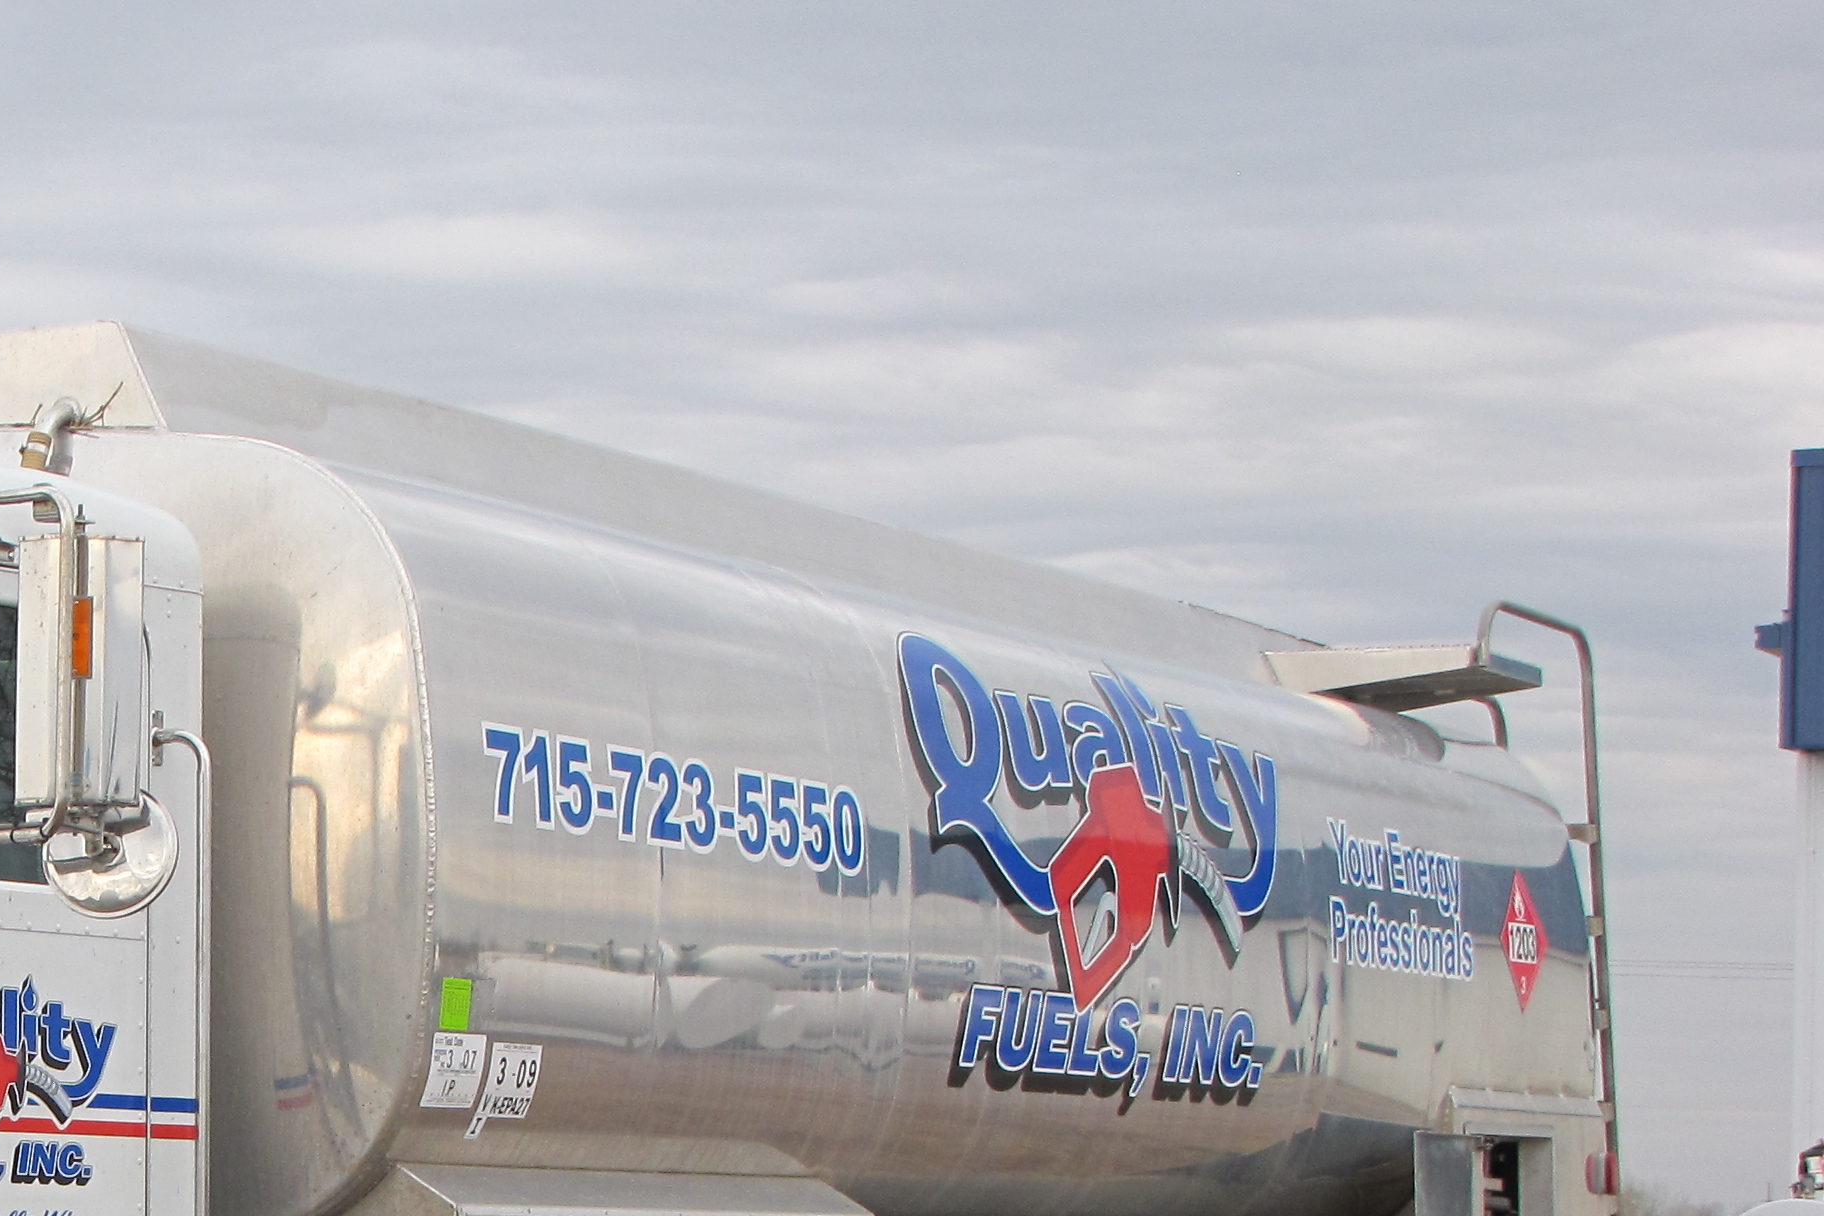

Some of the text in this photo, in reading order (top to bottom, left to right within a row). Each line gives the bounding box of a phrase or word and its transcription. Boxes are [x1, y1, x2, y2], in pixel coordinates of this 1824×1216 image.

[482, 721, 864, 877] 715-723-5550
[898, 631, 1276, 918] Quality
[1327, 817, 1461, 917] Your Energy
[1329, 896, 1474, 982] Professionals
[1509, 925, 1536, 962] 1203
[1519, 976, 1527, 994] 3
[496, 1057, 507, 1085] 3
[956, 984, 1263, 1098] FUELS, INC.
[13, 1140, 94, 1184] INC.
